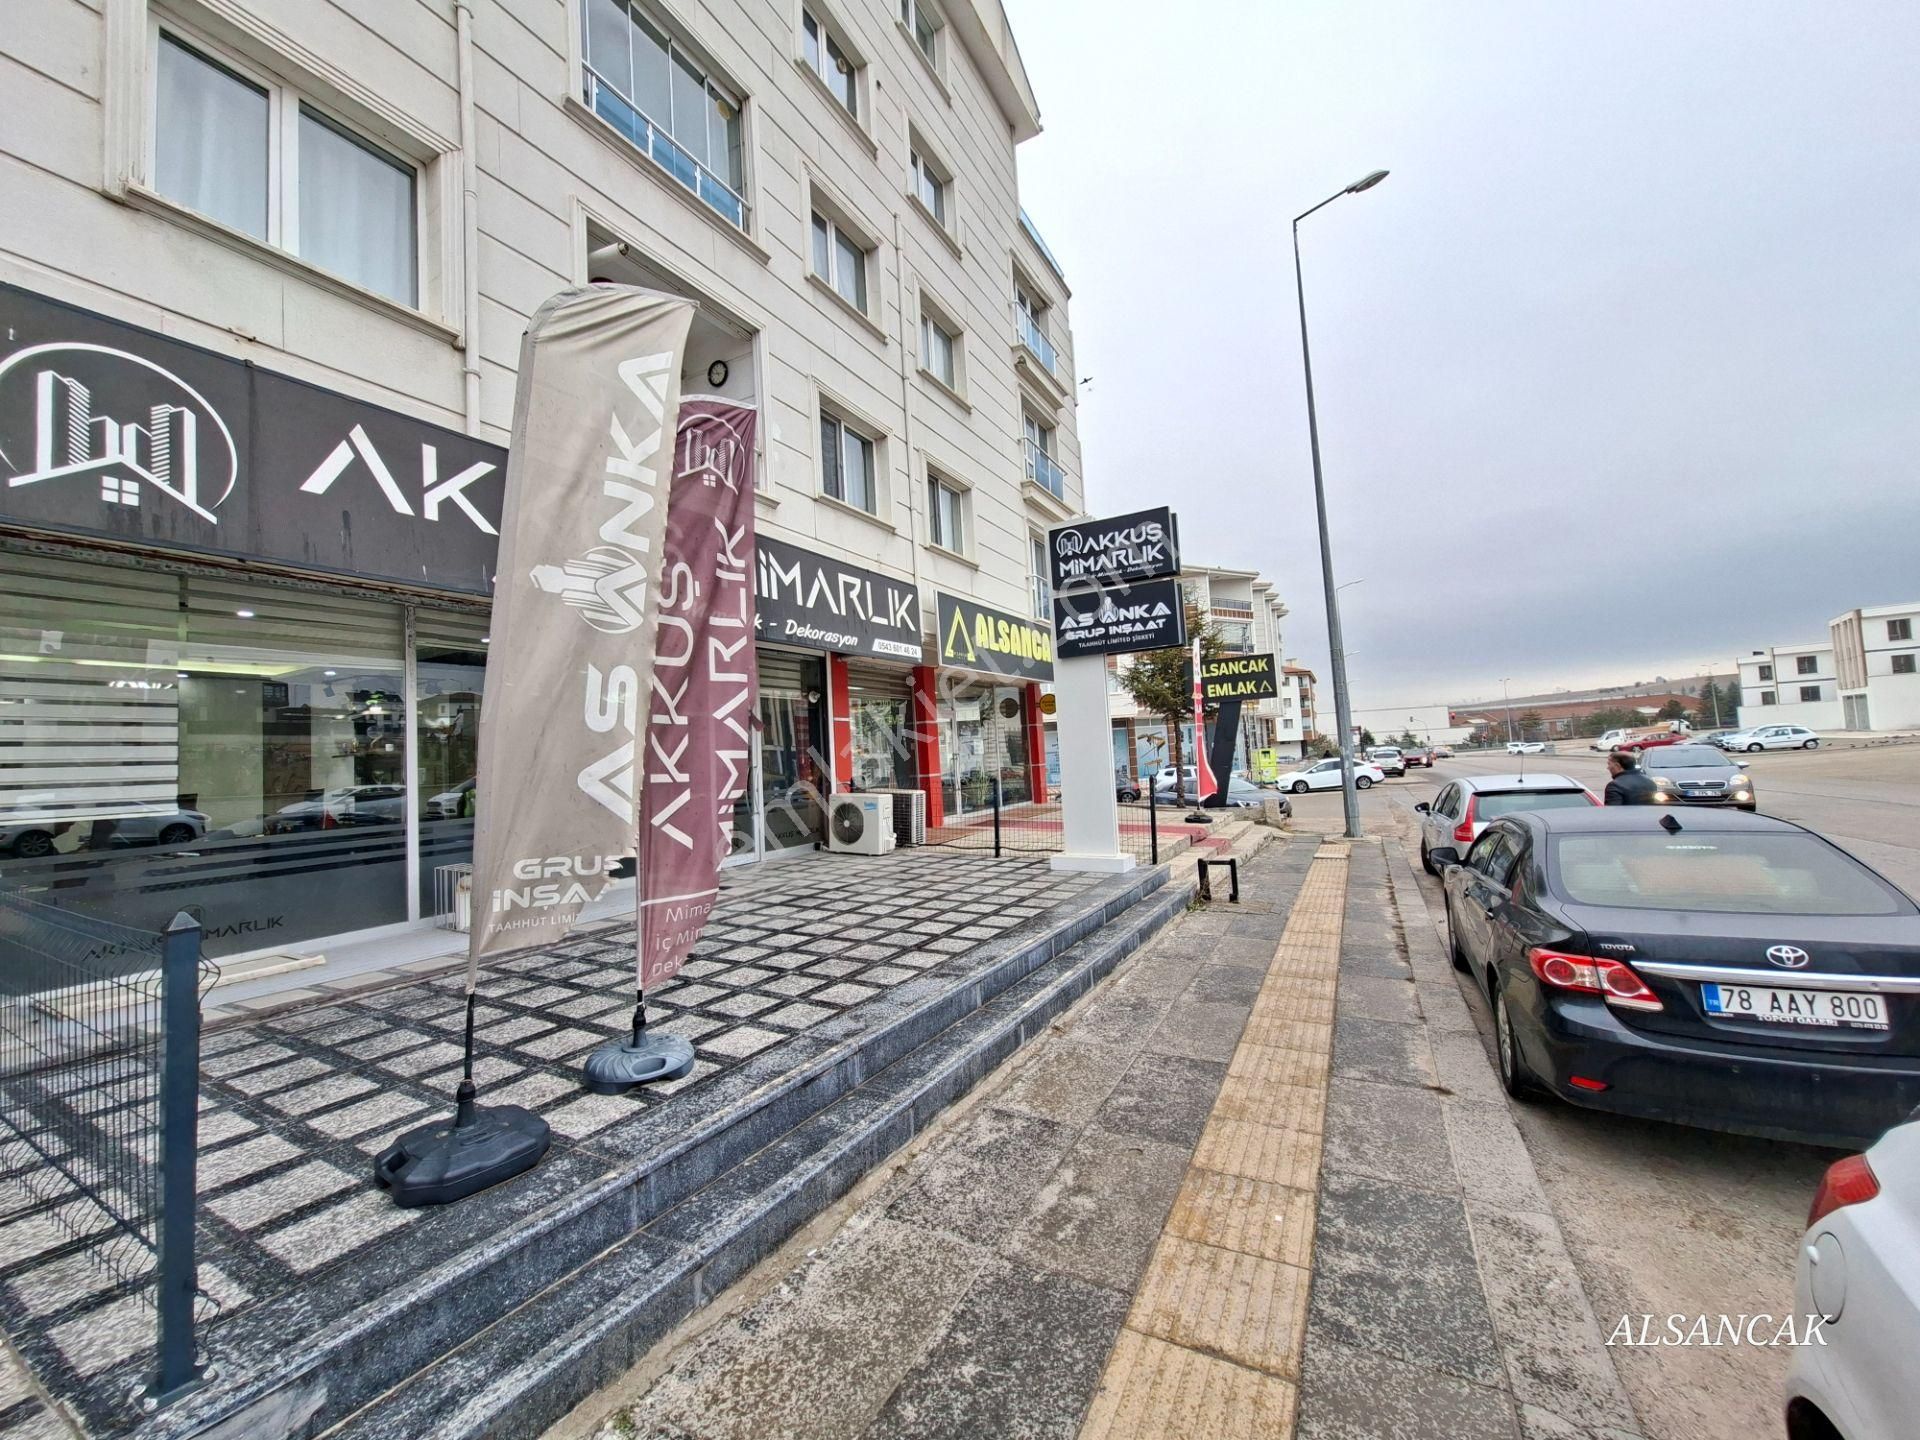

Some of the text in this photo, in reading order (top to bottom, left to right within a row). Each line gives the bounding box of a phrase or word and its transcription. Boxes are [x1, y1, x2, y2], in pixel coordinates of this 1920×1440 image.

[1082, 523, 1163, 554] AKKUŞ
[784, 619, 858, 648] Dekorasyon
[1065, 627, 1106, 641] GRUP
[1207, 680, 1257, 698] EMLAK
[1600, 942, 1636, 951] TOYOTA
[1721, 988, 1753, 1011] 78
[1770, 991, 1816, 1016] AAY
[1831, 995, 1879, 1020] 800
